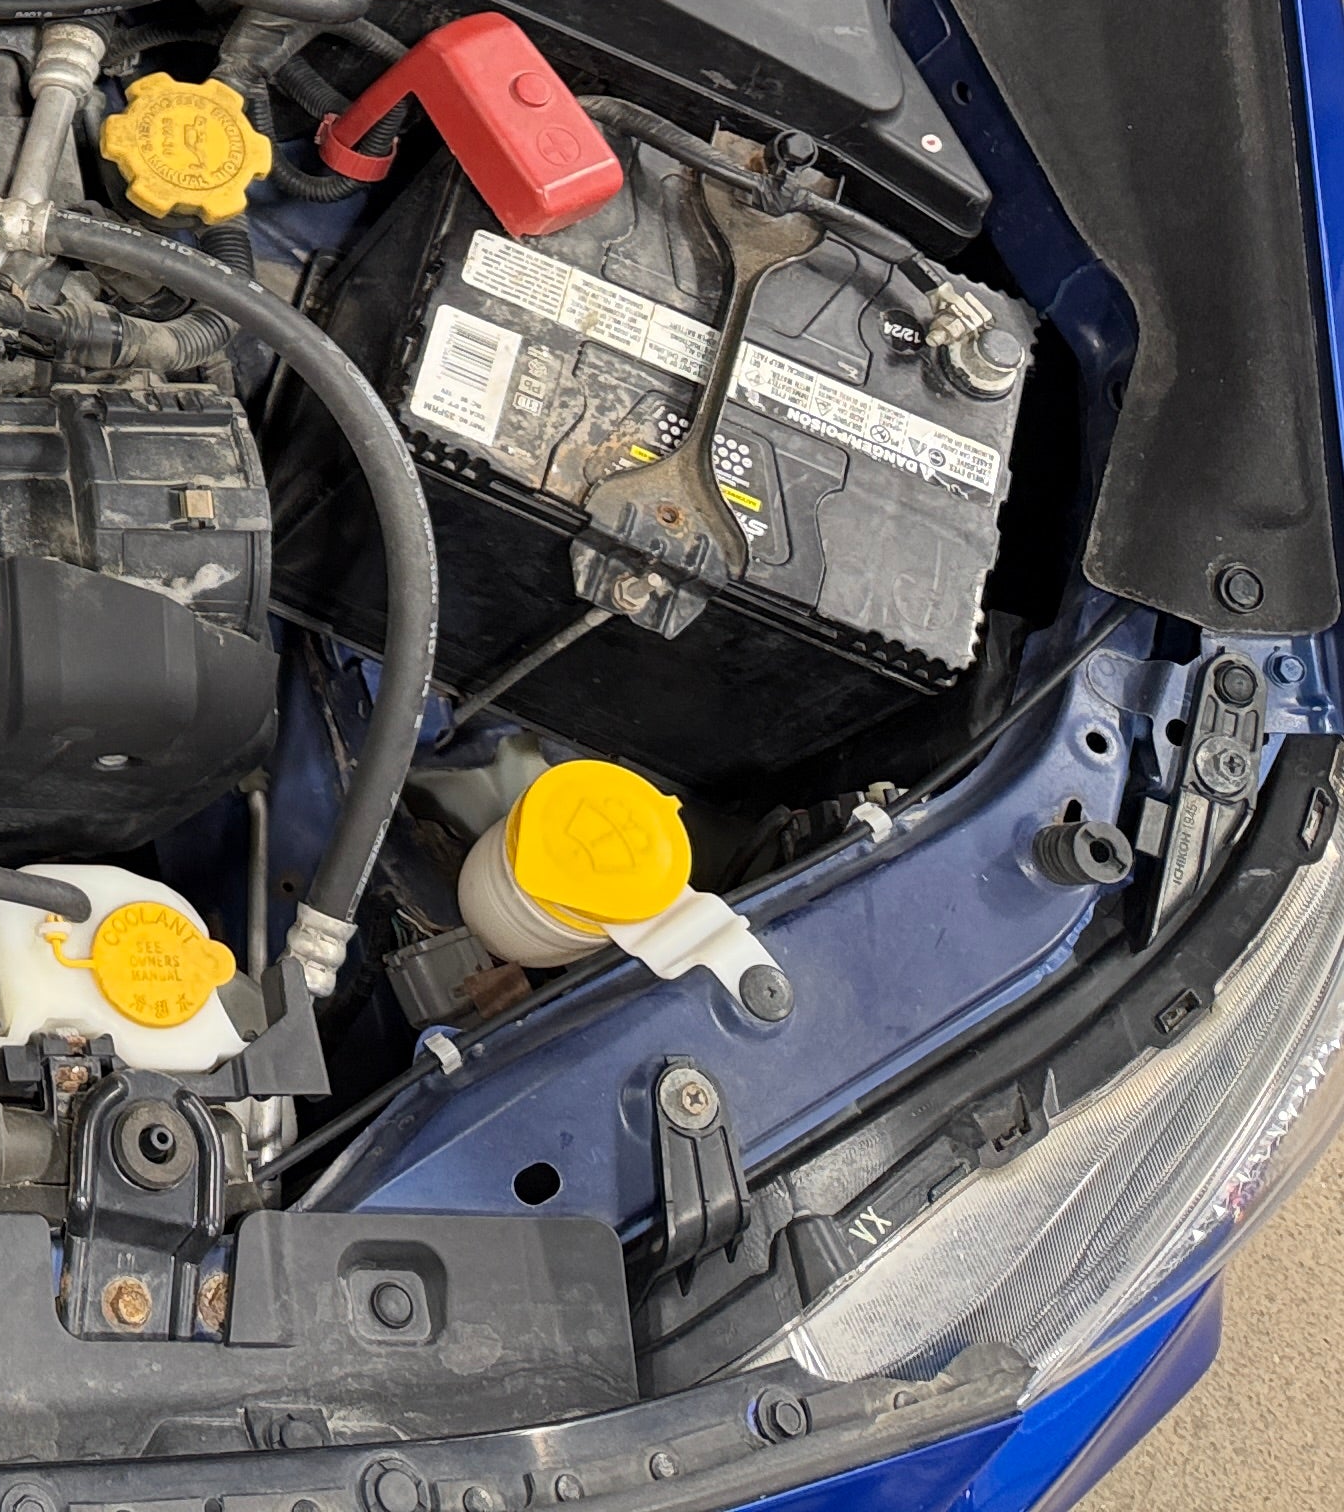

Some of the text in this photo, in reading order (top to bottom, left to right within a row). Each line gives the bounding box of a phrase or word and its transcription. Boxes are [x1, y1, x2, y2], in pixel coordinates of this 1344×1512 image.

[880, 319, 924, 346] 12/24
[102, 907, 200, 946] COOLANT
[136, 941, 162, 953] SEE
[131, 970, 182, 982] MANUAL
[848, 1205, 893, 1245] VX
